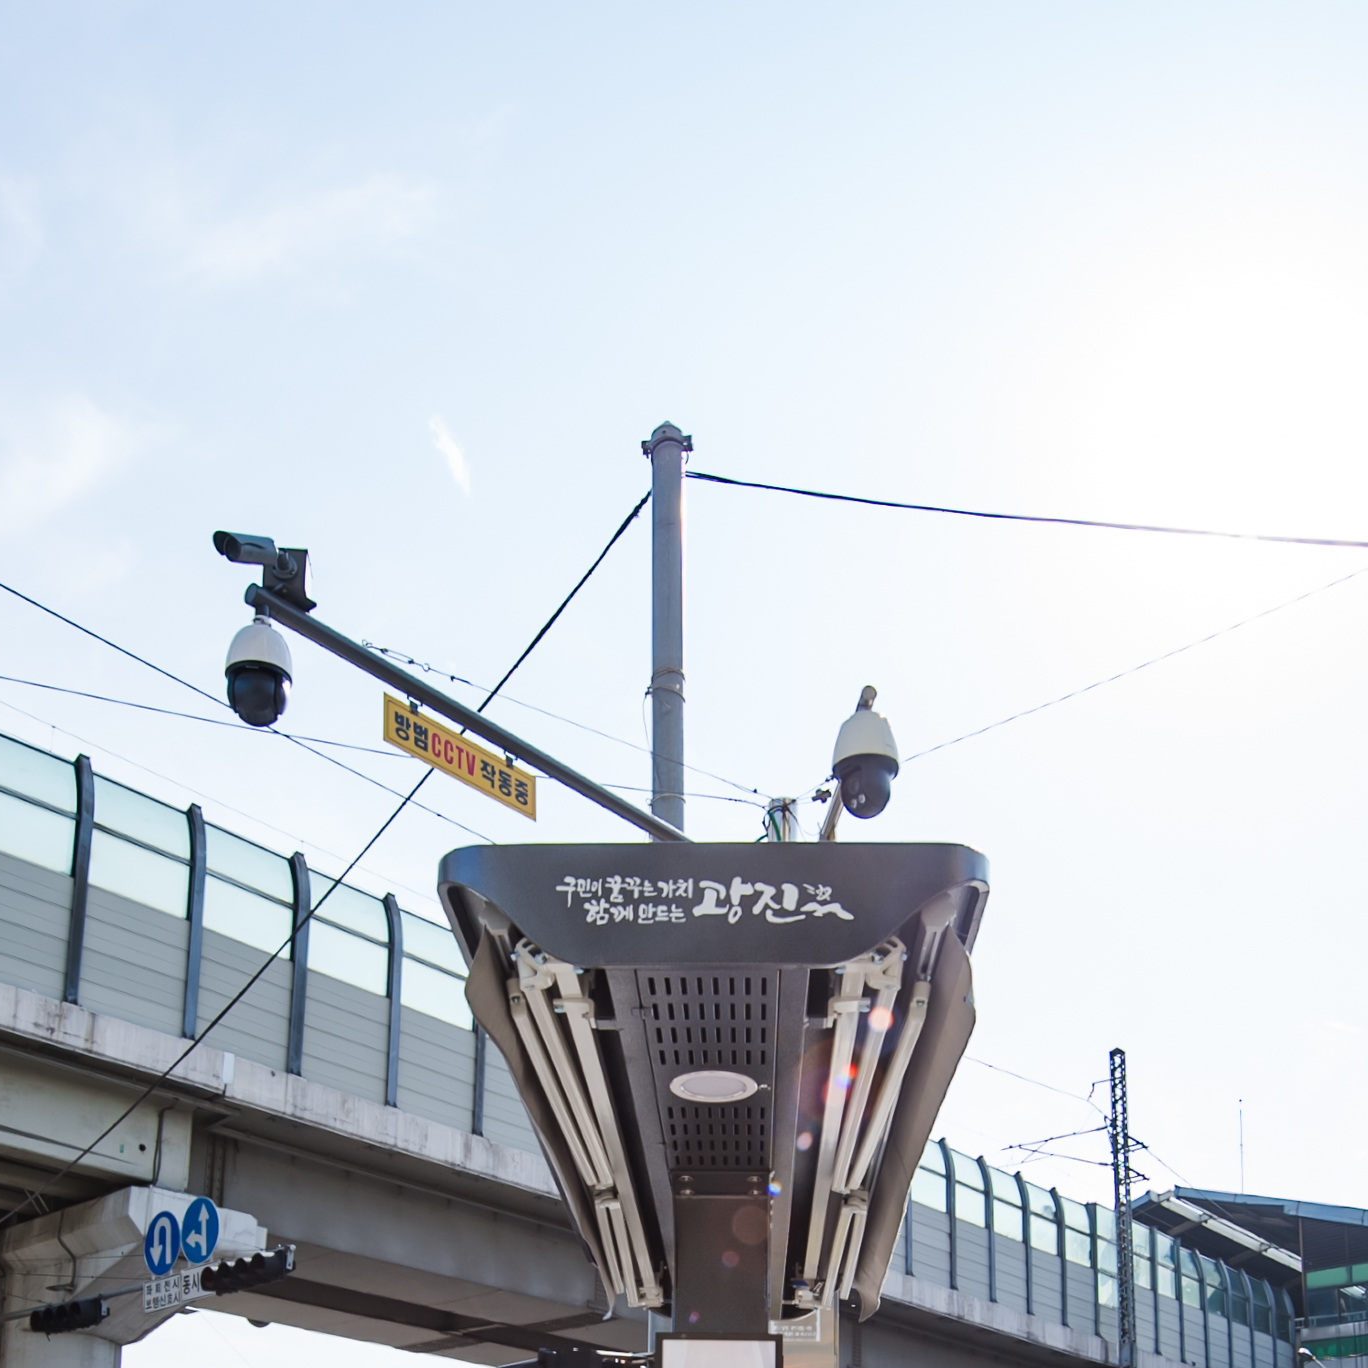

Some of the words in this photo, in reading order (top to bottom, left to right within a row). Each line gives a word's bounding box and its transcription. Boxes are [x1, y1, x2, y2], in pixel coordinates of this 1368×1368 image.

[480, 759, 529, 806] 작동중
[555, 875, 603, 907] 구민이
[605, 874, 657, 903] 꿈꾸는
[657, 877, 694, 900] 가치
[692, 875, 807, 925] 광진
[583, 898, 634, 926] 함께
[637, 902, 687, 924] 만드는
[182, 1271, 200, 1296] 동시
